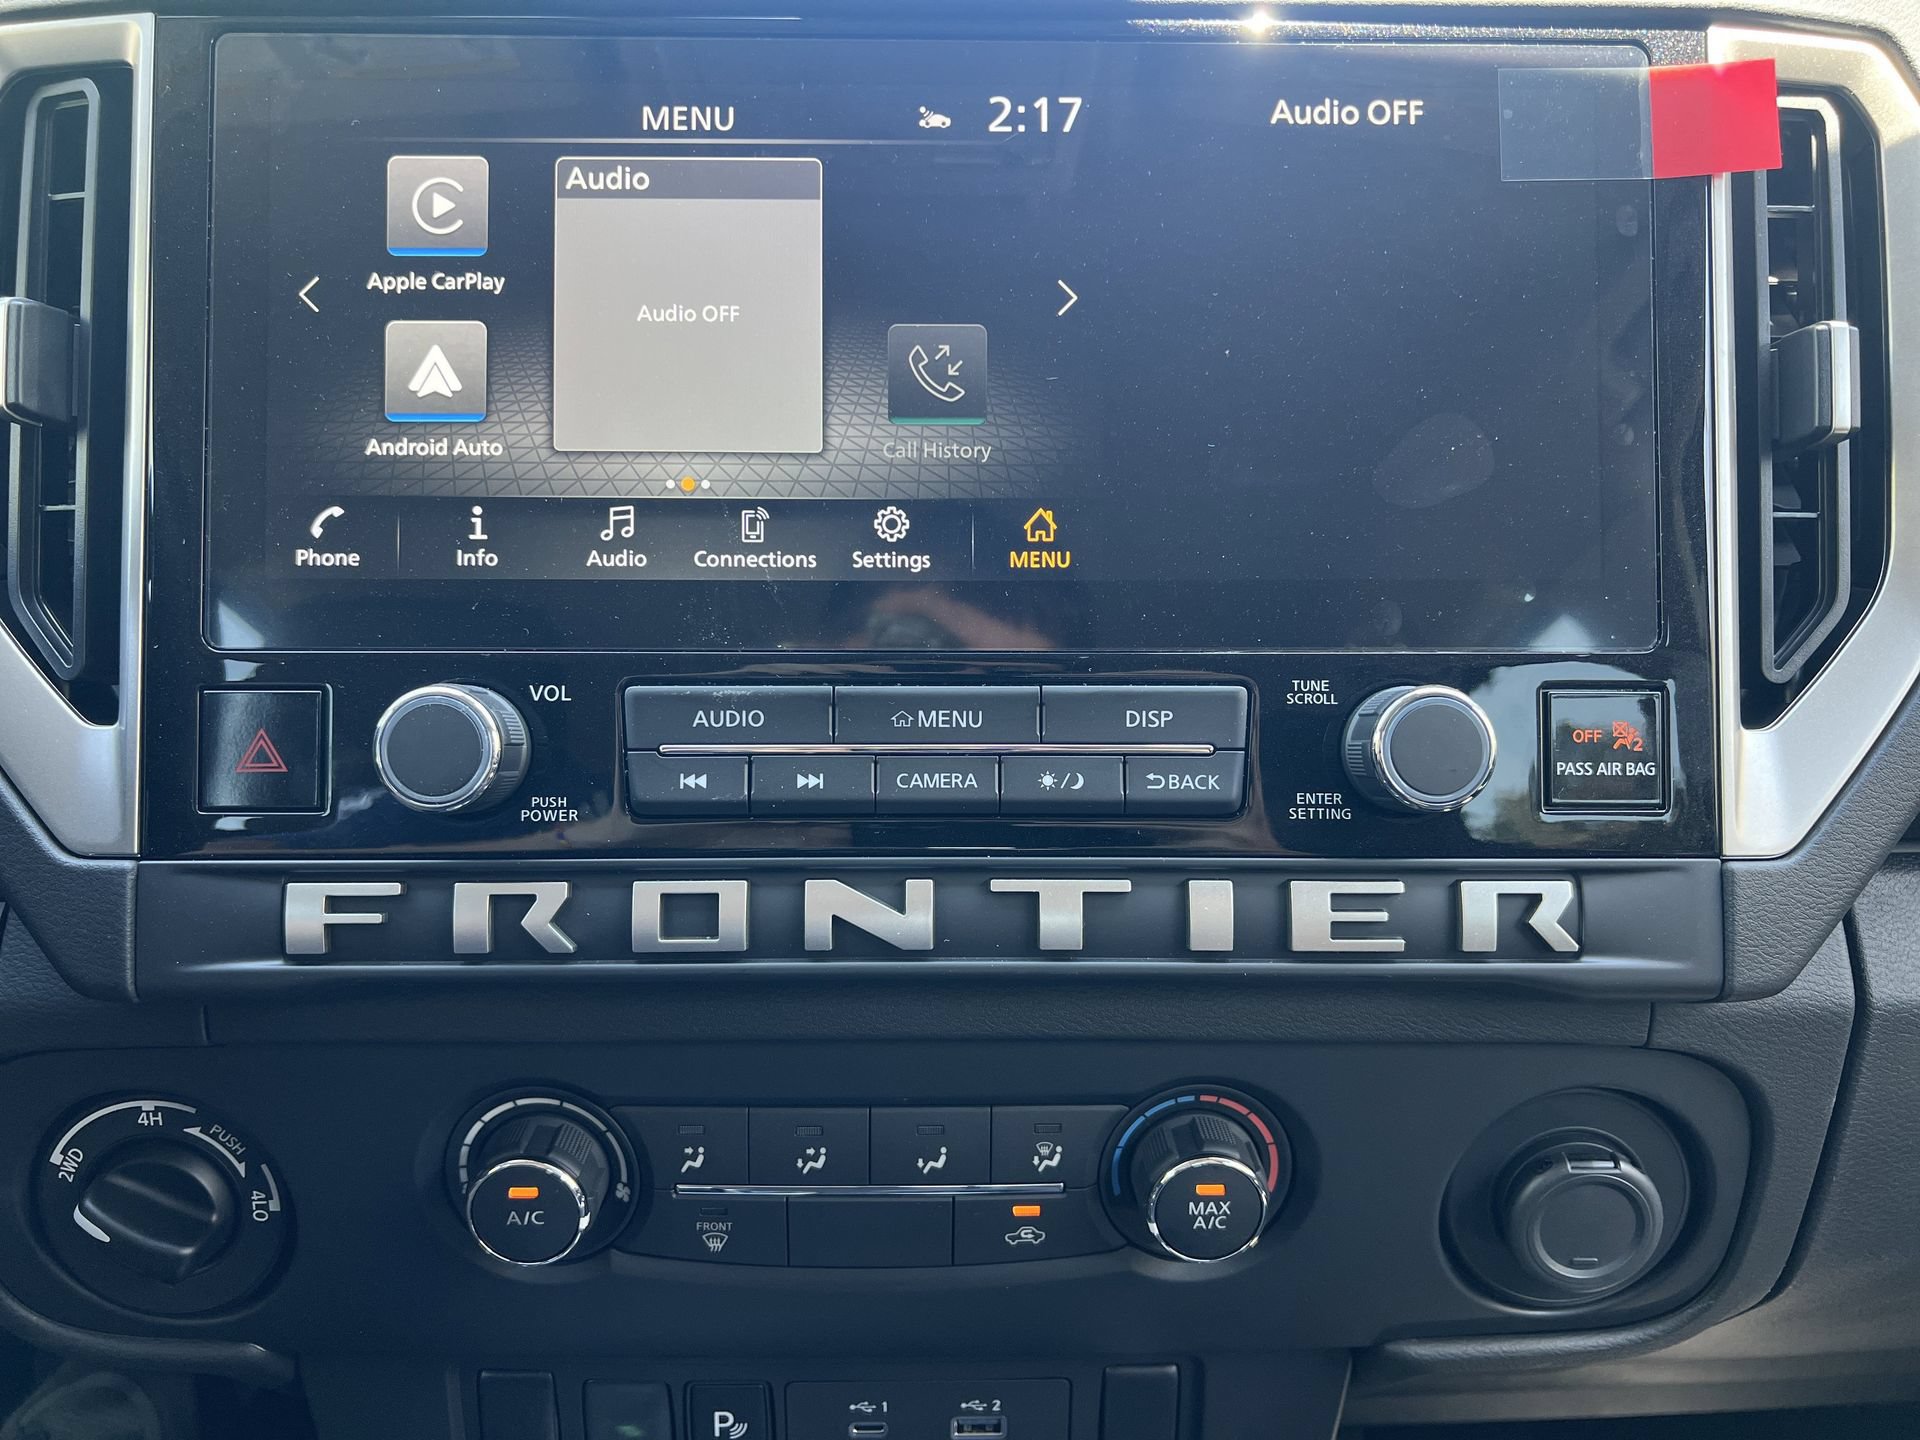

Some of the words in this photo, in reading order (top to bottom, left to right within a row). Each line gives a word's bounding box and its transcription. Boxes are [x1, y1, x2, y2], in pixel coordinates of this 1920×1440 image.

[642, 105, 735, 131] MENU
[988, 95, 1083, 133] 2:17
[1270, 97, 1360, 125] Audio
[1367, 99, 1424, 125] OFF
[565, 164, 650, 191] Audio
[366, 271, 428, 295] Apple
[431, 271, 506, 295] CarPlay
[636, 303, 697, 322] Audio
[702, 304, 740, 323] OFF
[364, 437, 448, 456] Android
[452, 438, 504, 456] Auto
[883, 441, 917, 459] Call
[923, 441, 992, 463] History
[295, 547, 361, 567] Phone
[456, 548, 499, 567] Info
[585, 548, 648, 568] Audio
[693, 550, 817, 568] Connections
[852, 550, 931, 573] Settings
[1010, 550, 1071, 569] MENU
[529, 684, 572, 702] VOL
[1291, 679, 1330, 692] TUNE
[1286, 692, 1339, 705] SCROLL
[692, 709, 765, 728] AUDIO
[918, 710, 983, 729] MENU
[1126, 710, 1174, 728] DISP
[1572, 729, 1603, 743] OFF
[1556, 761, 1593, 776] PASS
[1596, 761, 1623, 776] AIR
[1625, 761, 1656, 776] BAG
[896, 772, 978, 789] CAMERA
[1168, 774, 1221, 790] BACK
[531, 796, 567, 808] PUSH
[1296, 792, 1343, 805] ENTER
[520, 809, 579, 822] POWER
[1288, 807, 1352, 820] SETTING
[283, 878, 1580, 954] FRONTIER
[137, 1111, 163, 1127] 4H
[209, 1124, 246, 1156] PUSH
[58, 1147, 84, 1182] 2WD
[250, 1190, 269, 1222] 4LO
[1188, 1200, 1231, 1216] MAX
[506, 1210, 545, 1226] A/C
[1192, 1215, 1227, 1230] A/C
[696, 1221, 733, 1234] FRONT
[882, 1401, 888, 1413] 1
[991, 1399, 1001, 1412] 2
